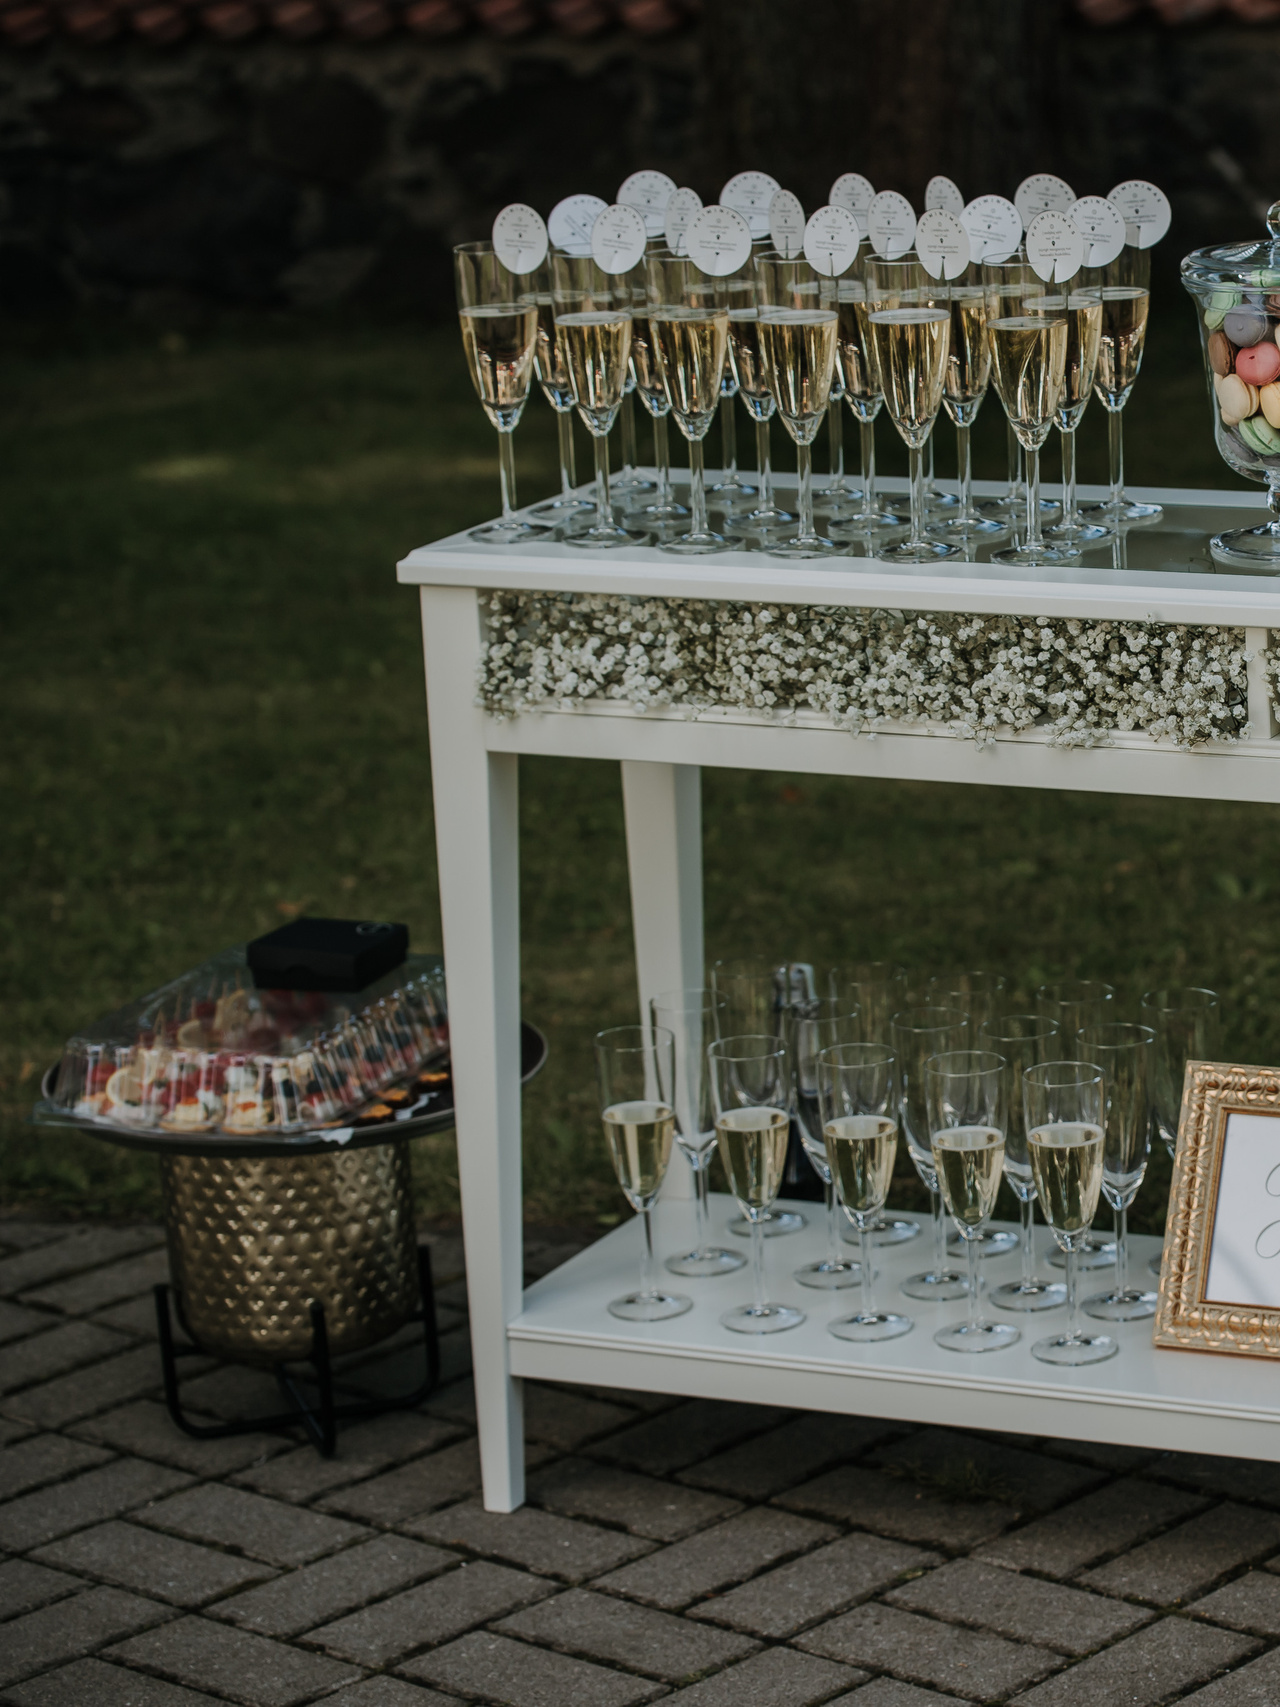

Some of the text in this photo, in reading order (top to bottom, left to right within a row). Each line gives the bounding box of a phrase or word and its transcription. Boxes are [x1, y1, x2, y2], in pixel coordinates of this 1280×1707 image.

[1112, 183, 1162, 202] RIMINIMAS
[1070, 199, 1119, 224] PRIMINIMAS
[1031, 213, 1076, 237] PRIMINIMAS
